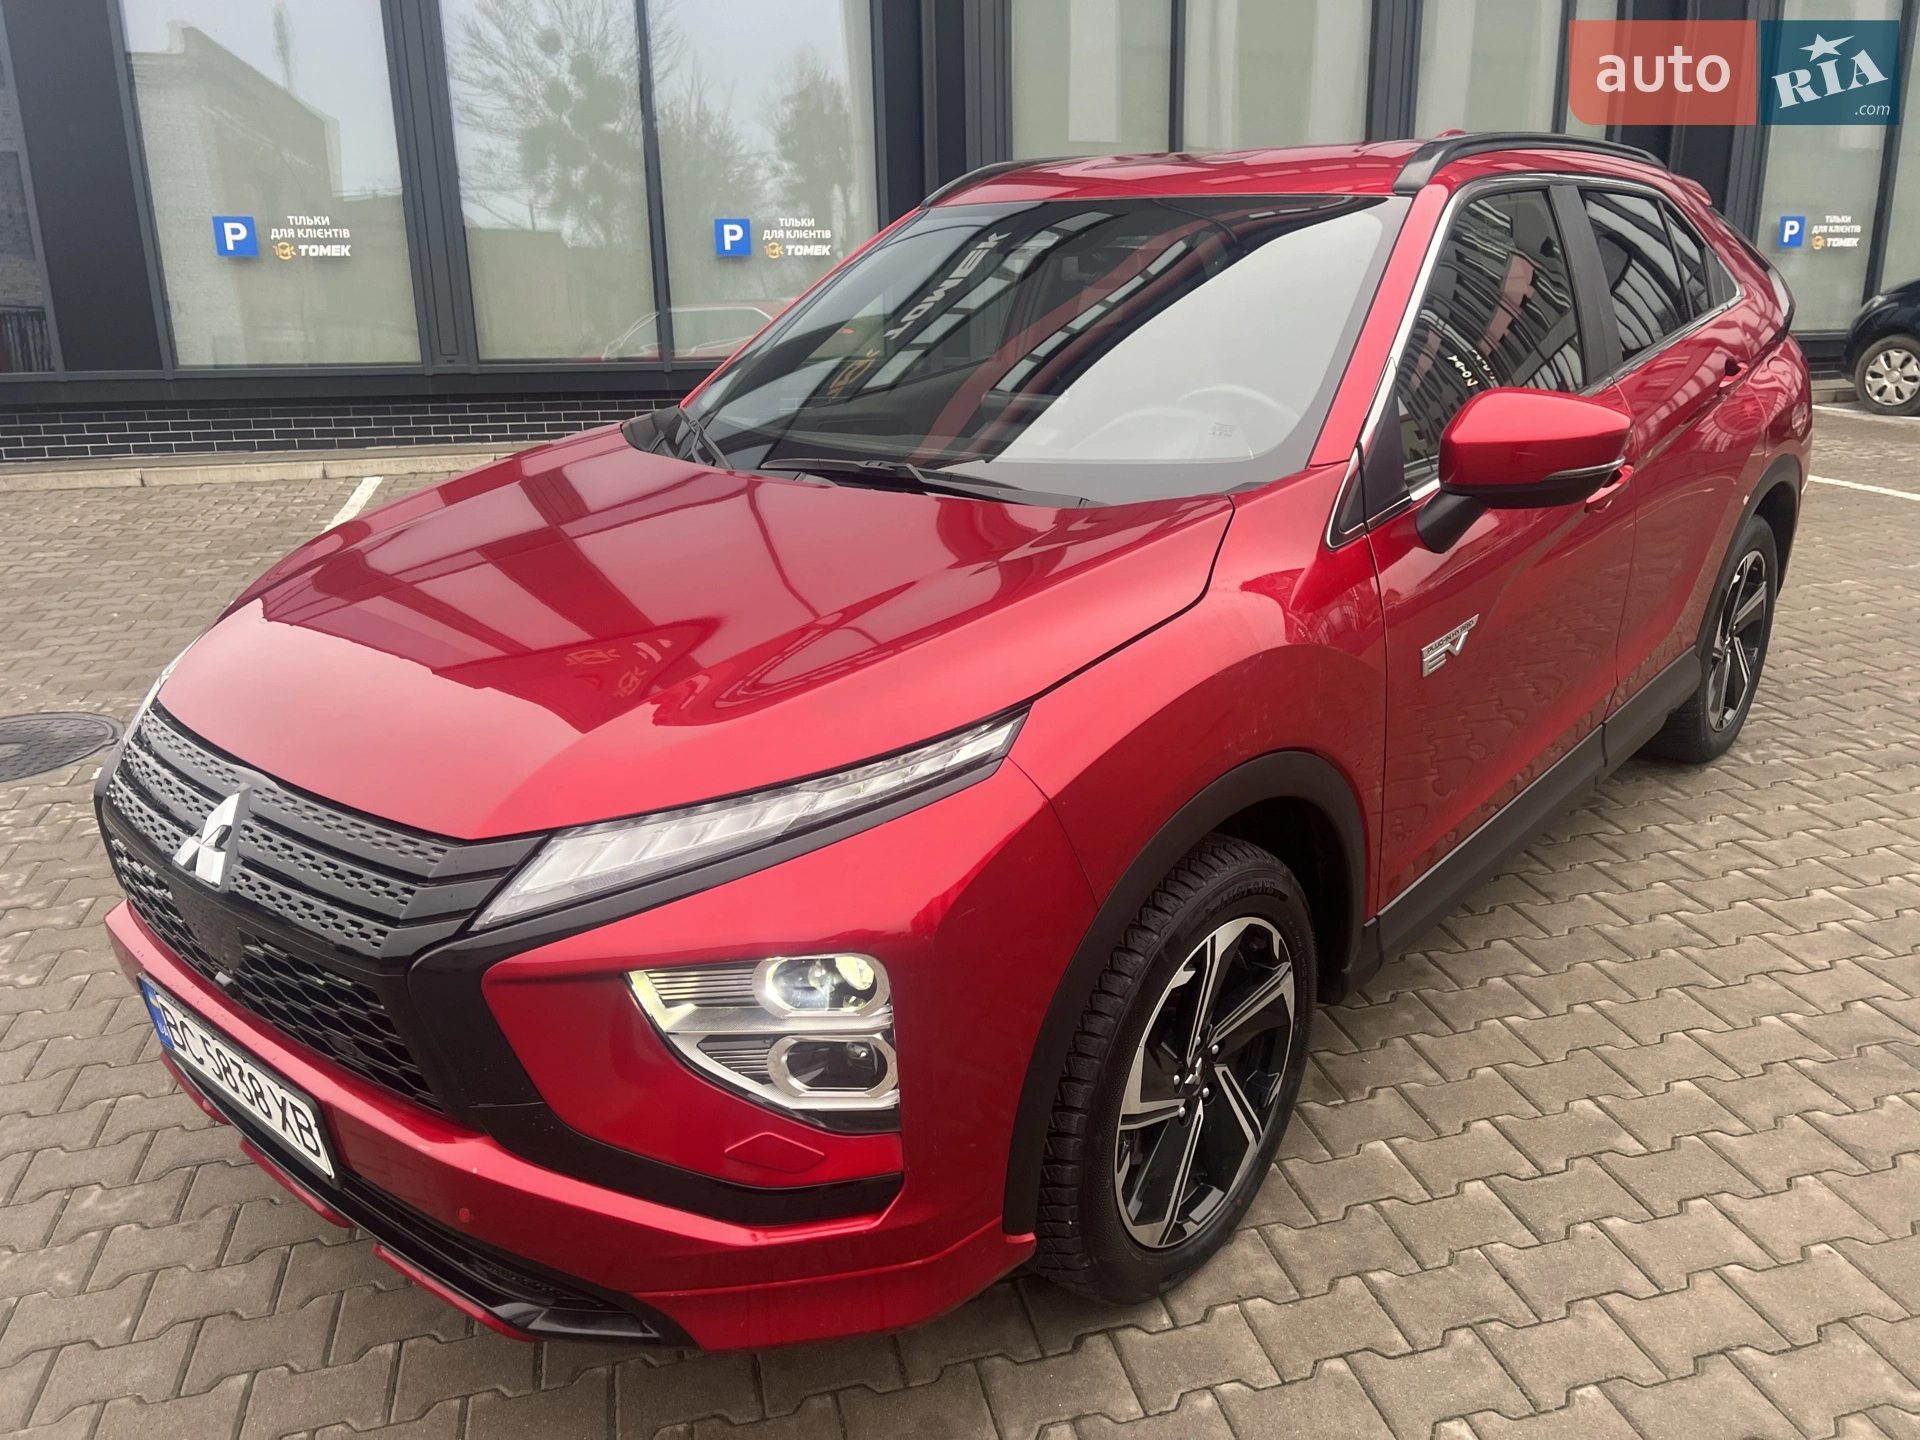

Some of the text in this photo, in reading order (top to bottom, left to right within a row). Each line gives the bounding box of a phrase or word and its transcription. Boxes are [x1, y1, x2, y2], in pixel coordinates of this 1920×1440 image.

[287, 215, 330, 226] ТІЛЬКИ
[779, 217, 815, 227] ТІЛЬКИ
[223, 222, 247, 250] P
[270, 228, 351, 240] ДЛЯ КЛІЄНТІВ
[723, 224, 744, 251] P
[762, 229, 832, 241] ДЛЯ КЛІЄНТІВ
[1783, 220, 1800, 243] P
[298, 244, 352, 257] TOMEK
[785, 244, 832, 256] TOMEK
[160, 1001, 205, 1066] BC
[199, 1034, 273, 1120] 5838
